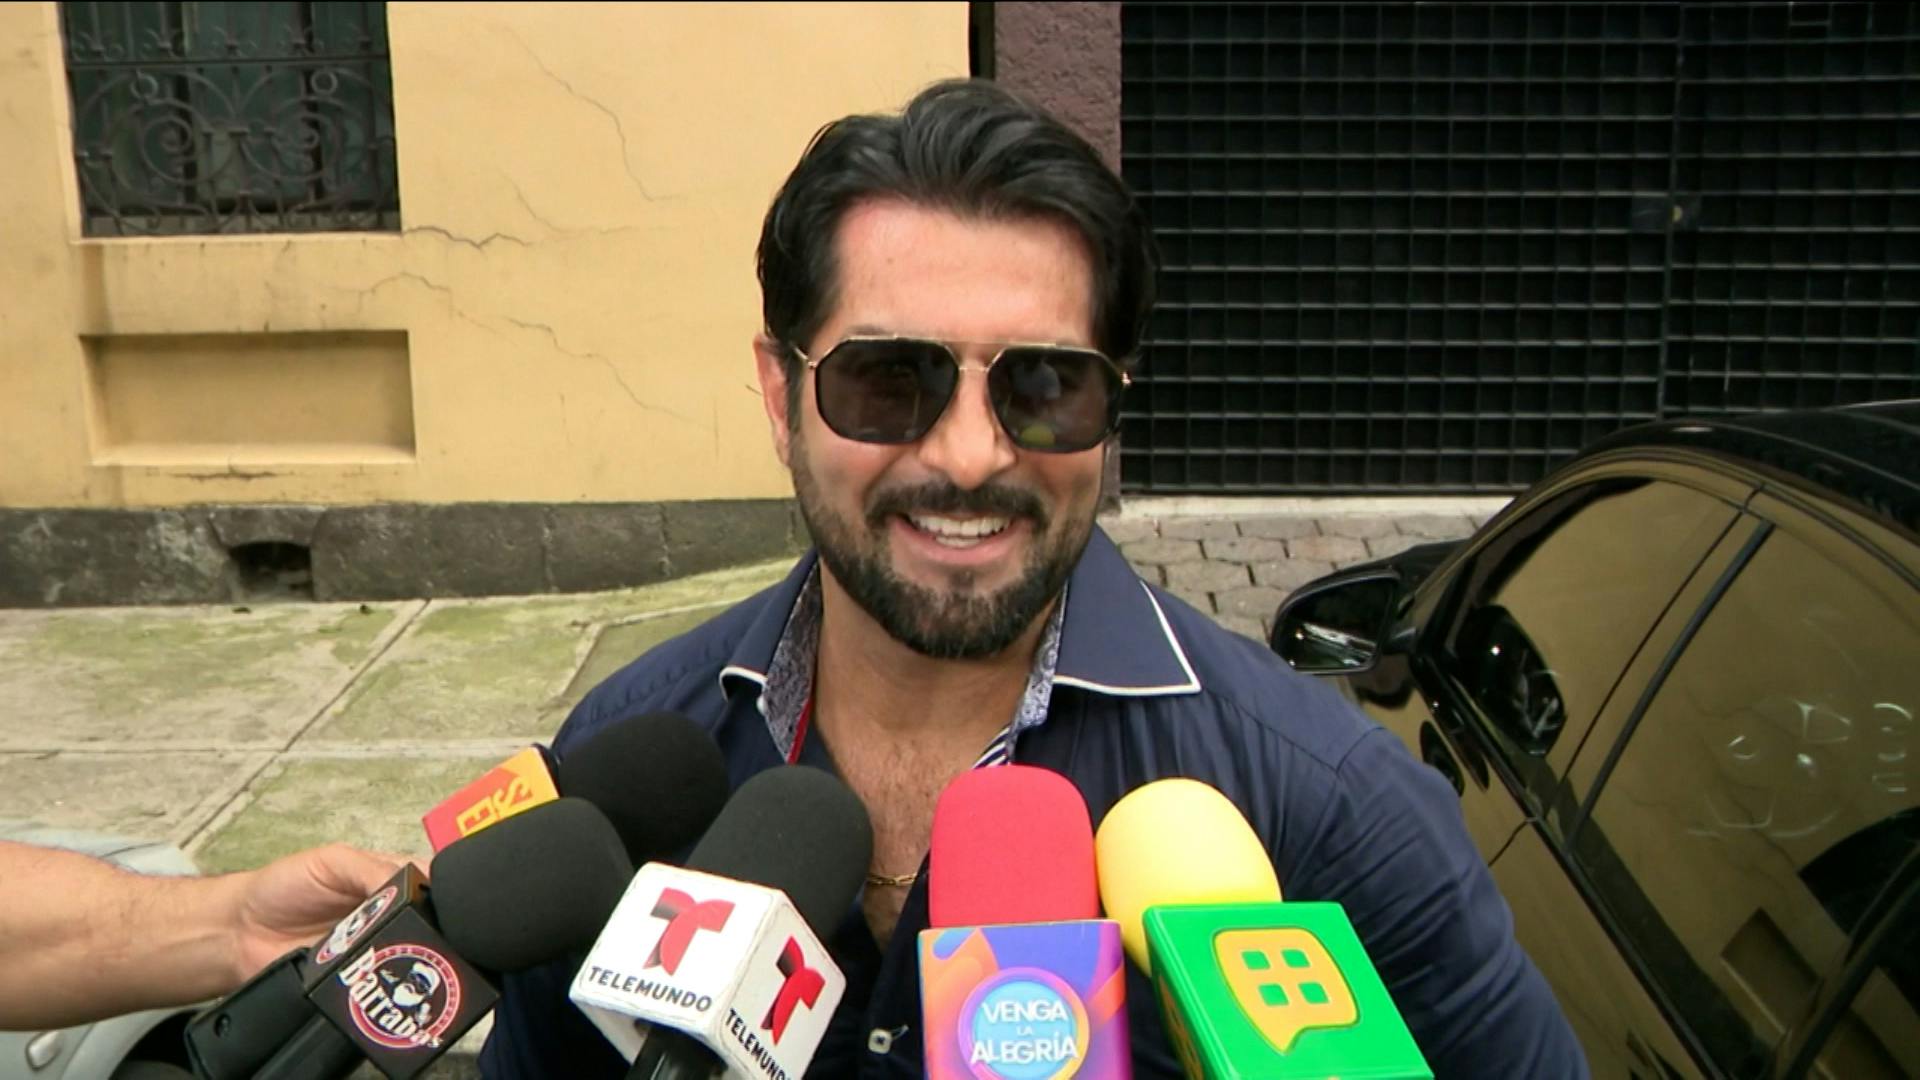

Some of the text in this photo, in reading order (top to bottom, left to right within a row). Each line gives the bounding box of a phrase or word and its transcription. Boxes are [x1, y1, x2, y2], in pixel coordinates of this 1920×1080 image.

[588, 966, 712, 1013] TELEMUNDO
[982, 999, 1069, 1024] VENGA
[726, 1008, 791, 1080] TELEMUND
[970, 1031, 1080, 1065] ALEGRÍA
[1016, 1026, 1034, 1036] LA
